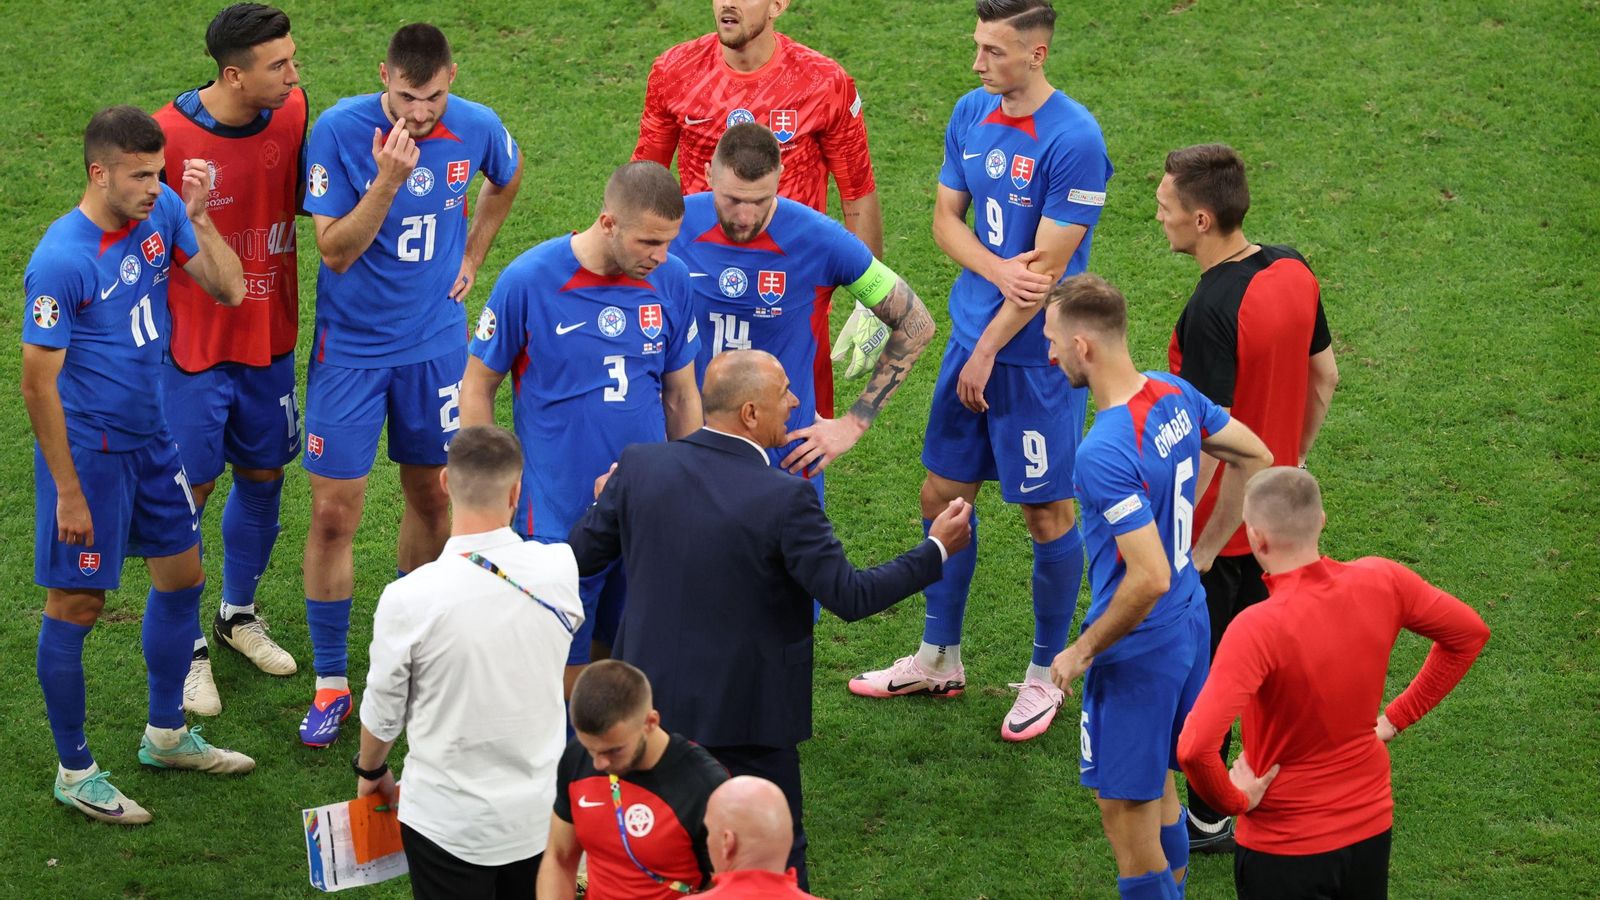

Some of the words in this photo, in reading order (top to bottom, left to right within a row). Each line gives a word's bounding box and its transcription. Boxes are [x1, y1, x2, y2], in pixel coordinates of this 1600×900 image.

[204, 196, 234, 208] RO2024
[986, 197, 1004, 247] 9
[398, 213, 437, 262] 21
[130, 293, 159, 347] 11
[709, 312, 752, 358] 14
[603, 355, 628, 402] 3
[438, 379, 463, 433] 2
[1022, 430, 1048, 478] 9
[174, 464, 197, 516] 1
[1174, 456, 1194, 574] 6
